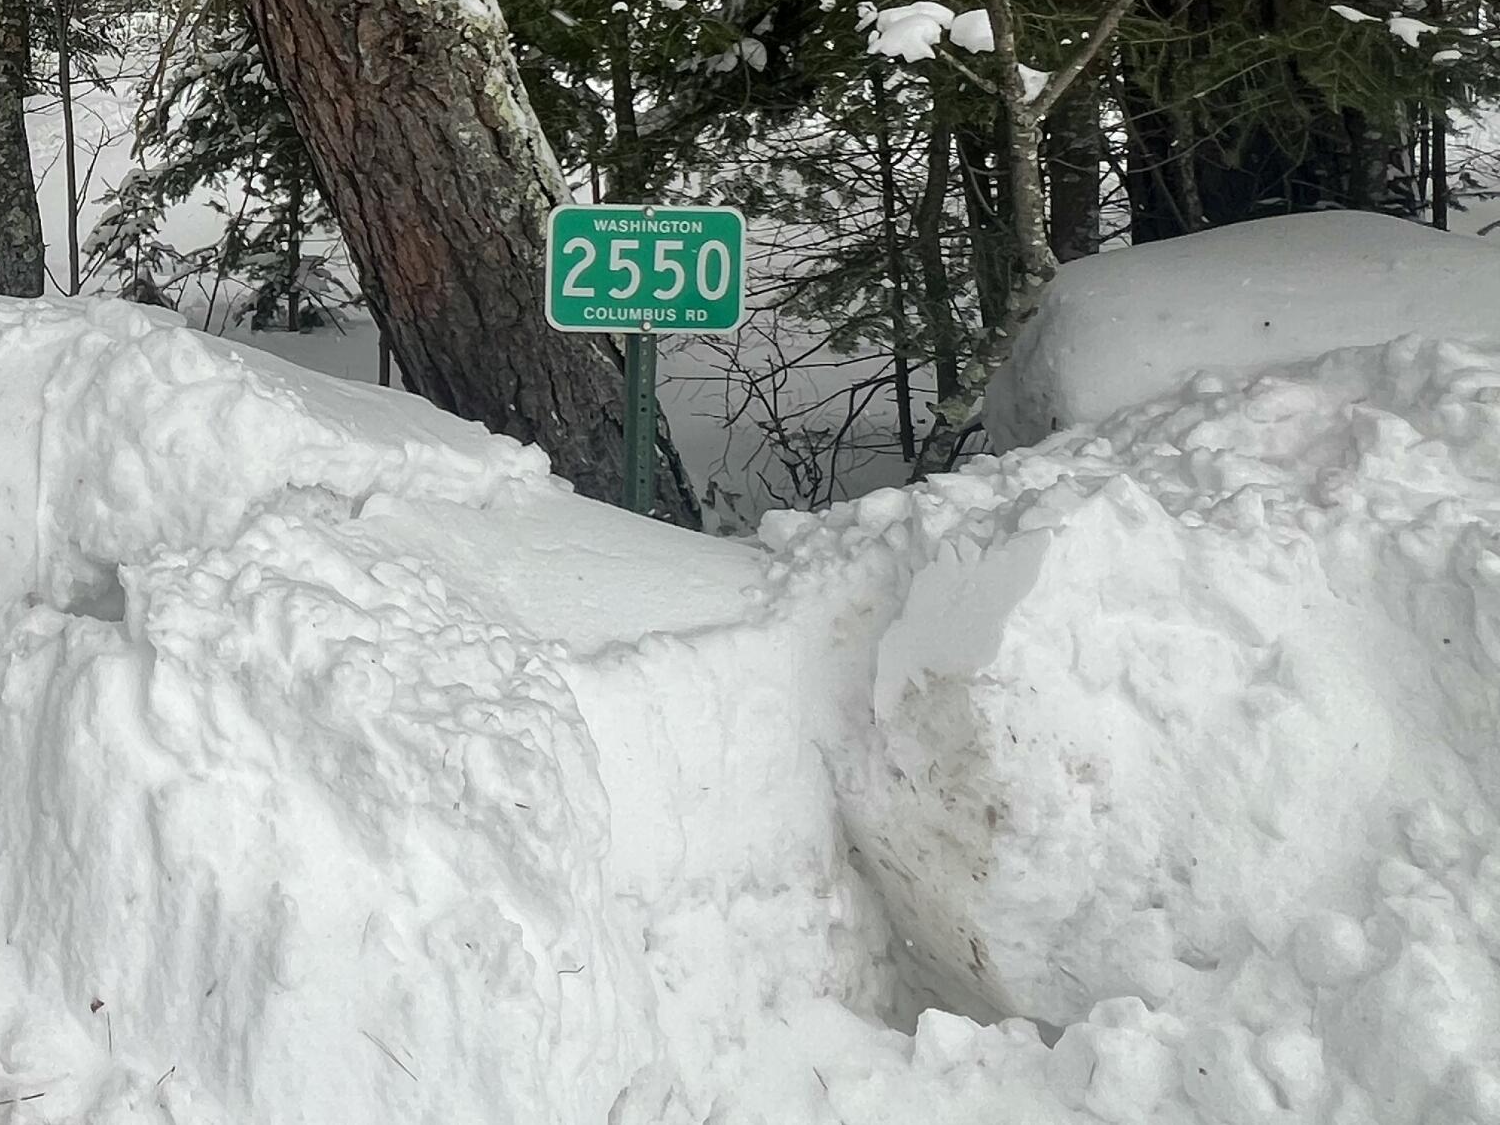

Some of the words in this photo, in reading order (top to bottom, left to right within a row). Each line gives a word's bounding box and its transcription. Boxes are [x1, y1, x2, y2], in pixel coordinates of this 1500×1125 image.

[594, 219, 703, 233] WASHINGTON
[562, 237, 731, 300] 2550
[583, 307, 677, 321] COLUMBUS
[685, 309, 708, 322] RD
